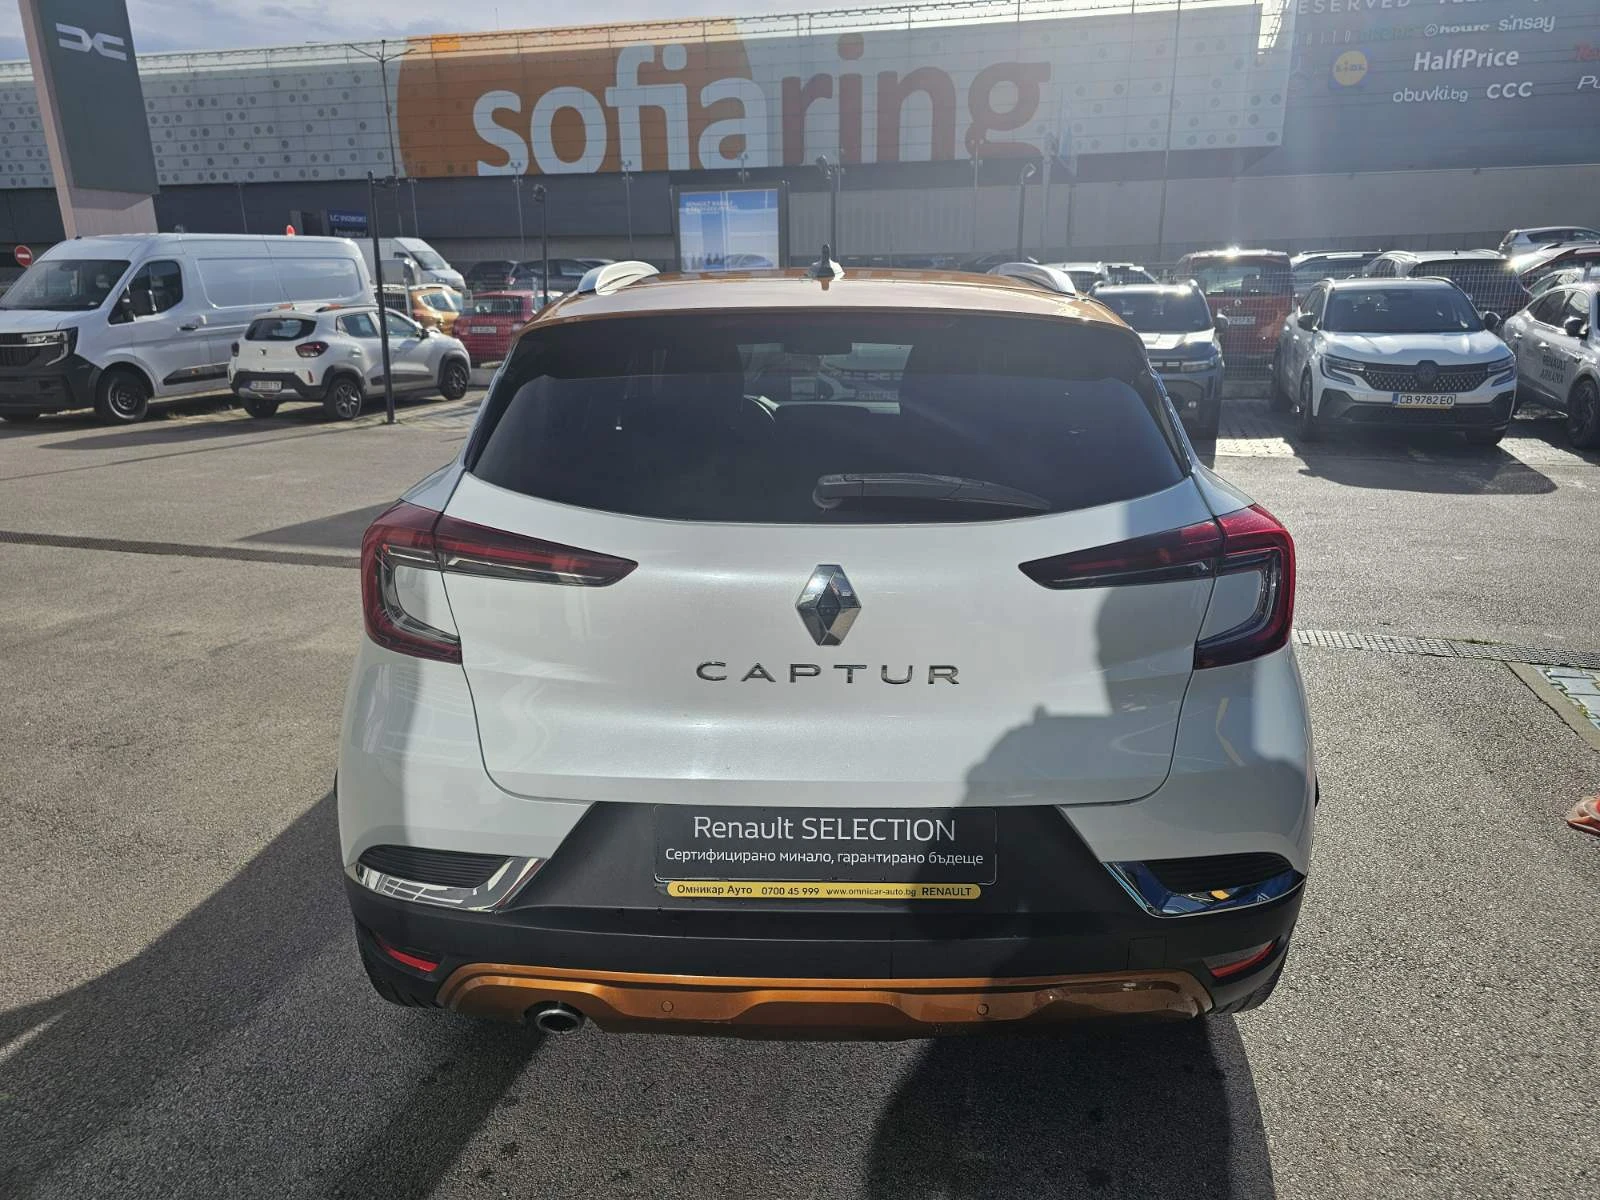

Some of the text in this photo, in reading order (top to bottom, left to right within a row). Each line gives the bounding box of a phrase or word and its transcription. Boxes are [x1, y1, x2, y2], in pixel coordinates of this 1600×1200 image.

[1298, 0, 1410, 14] ESERVED
[1498, 14, 1556, 33] sinsay
[1413, 49, 1520, 72] HalfPrice
[1392, 85, 1469, 103] obuvki.bg
[1486, 82, 1533, 100] CCC
[1400, 395, 1413, 404] CB
[1414, 395, 1438, 405] 9782
[696, 661, 960, 685] CAPTUR
[694, 816, 955, 841] Renault SELECTION
[665, 848, 984, 866] Сертифицирано минало, гарантирано бъдеще
[676, 884, 972, 898] Омникар Ауто 0700 45 999 www.omnicar-auto.bg RENAULT
